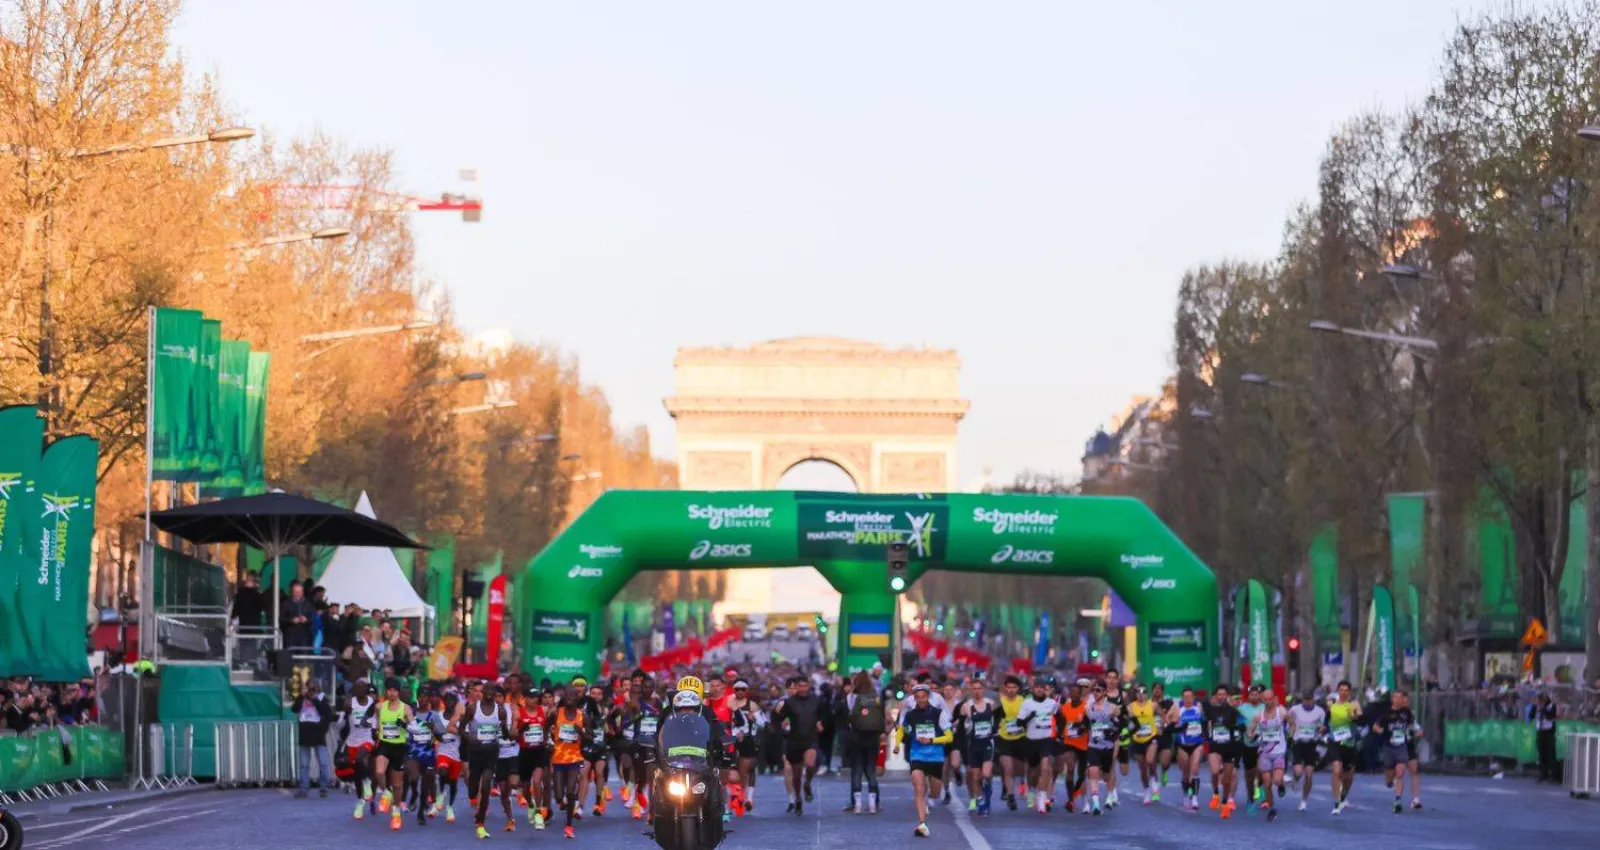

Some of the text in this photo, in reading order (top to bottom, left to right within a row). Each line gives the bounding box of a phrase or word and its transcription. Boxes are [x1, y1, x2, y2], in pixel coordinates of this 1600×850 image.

[687, 504, 774, 530] Schneider
[723, 519, 772, 529] Electric
[825, 510, 895, 523] Schneider
[973, 507, 1059, 535] Schneider
[1007, 524, 1056, 535] Electric
[56, 520, 68, 561] PARIS
[38, 527, 50, 585] Schneider
[579, 543, 622, 559] Schneider
[710, 543, 752, 557] asics
[1011, 549, 1055, 564] asics
[1120, 554, 1164, 569] Schneider
[533, 655, 585, 674] Schneider
[1152, 666, 1205, 685] Schneider
